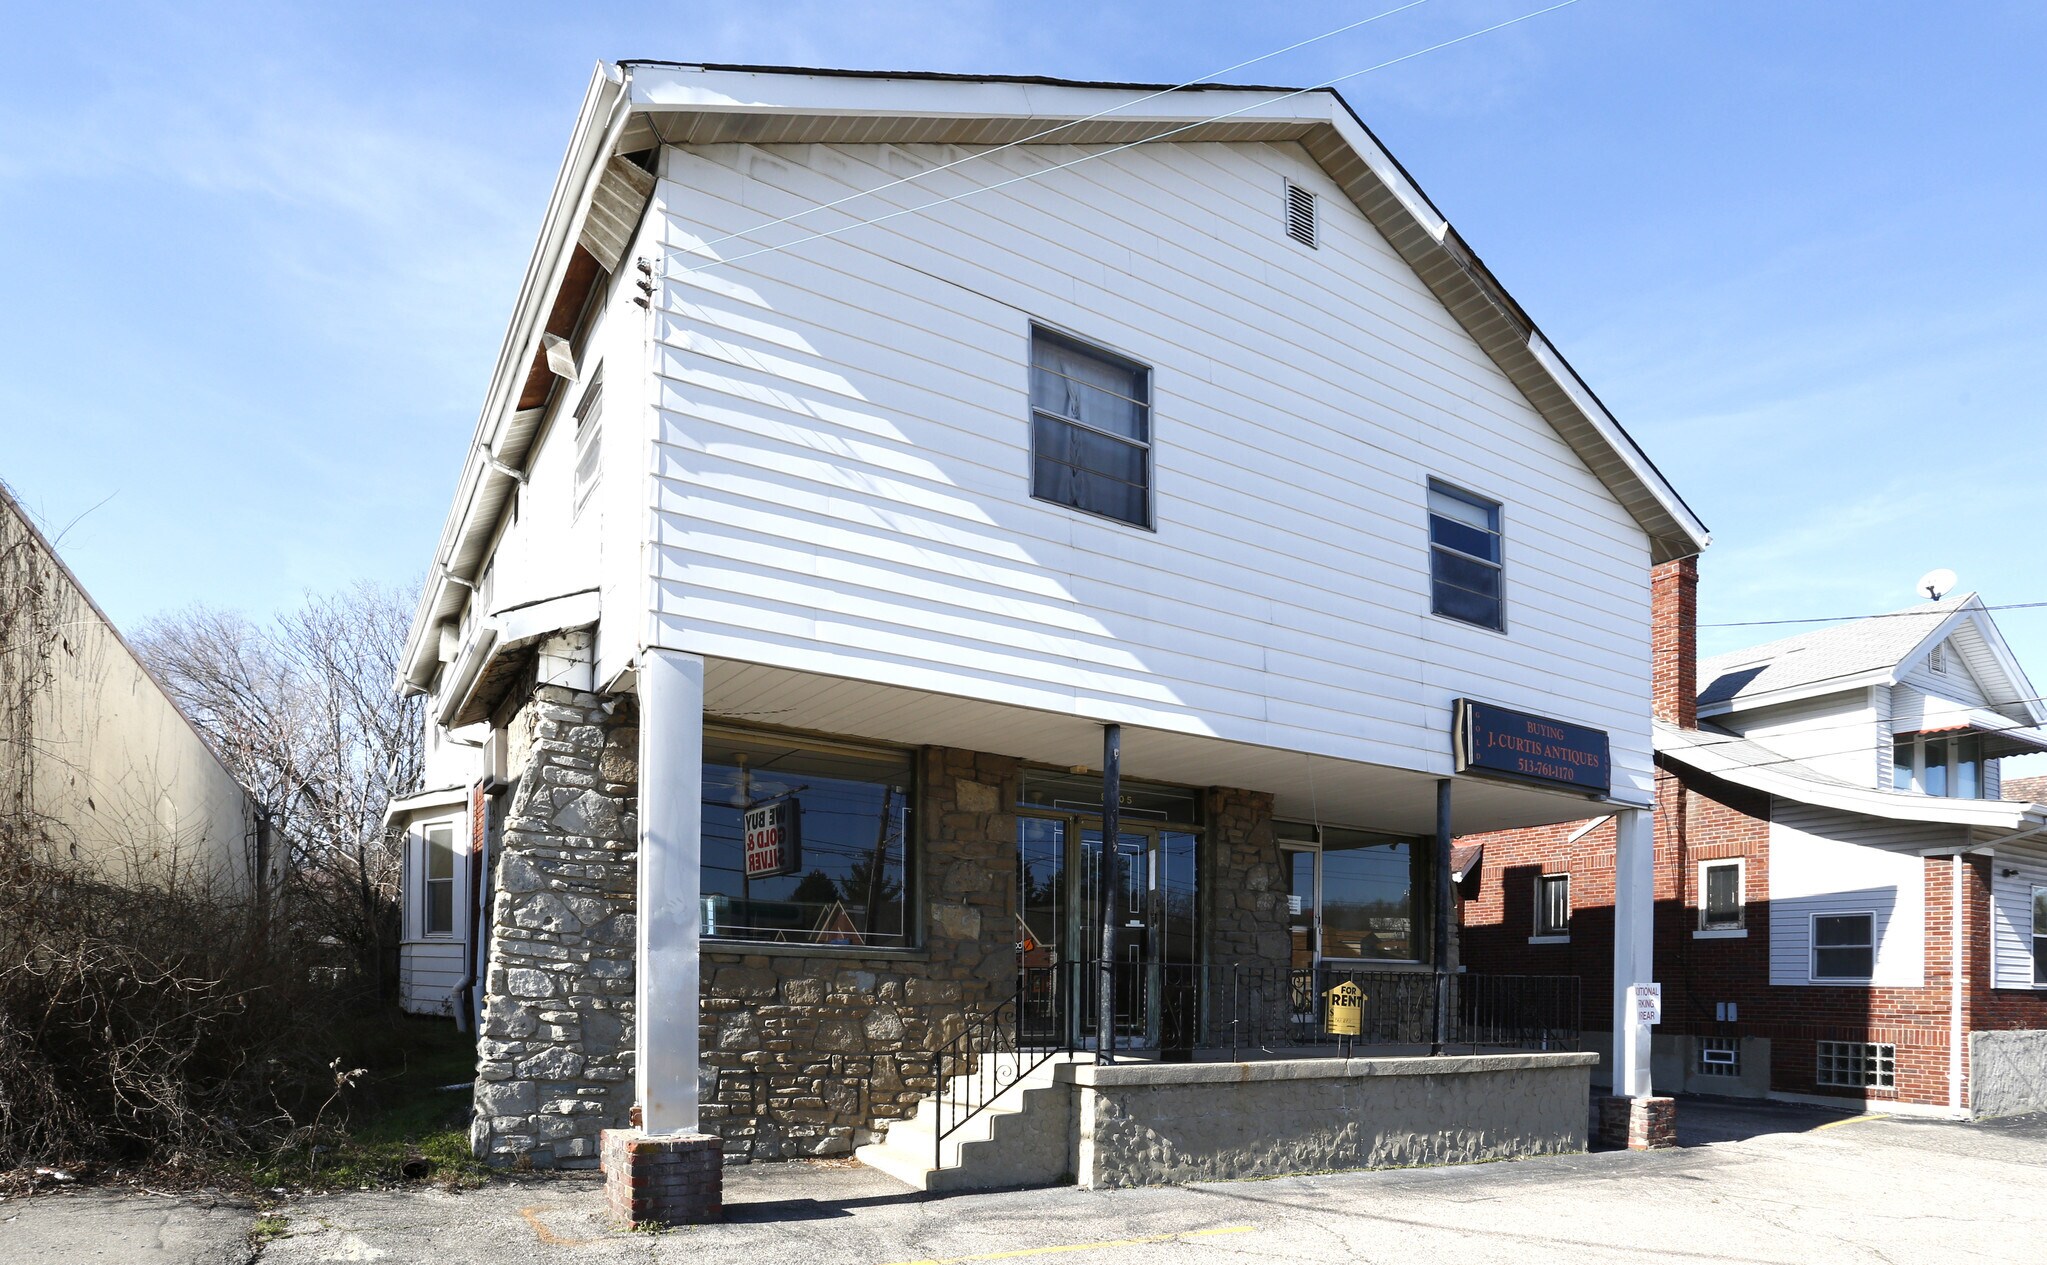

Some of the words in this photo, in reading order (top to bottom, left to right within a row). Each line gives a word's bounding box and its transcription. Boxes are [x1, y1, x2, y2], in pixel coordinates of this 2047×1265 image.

[1527, 721, 1564, 740] BUYING
[1488, 732, 1496, 748] J.
[1498, 733, 1542, 754] CURTIS
[1544, 746, 1599, 768] ANTIQUES
[1518, 757, 1574, 781] 513-761-1170
[1332, 993, 1362, 1007] RENT
[1341, 986, 1356, 995] FOR
